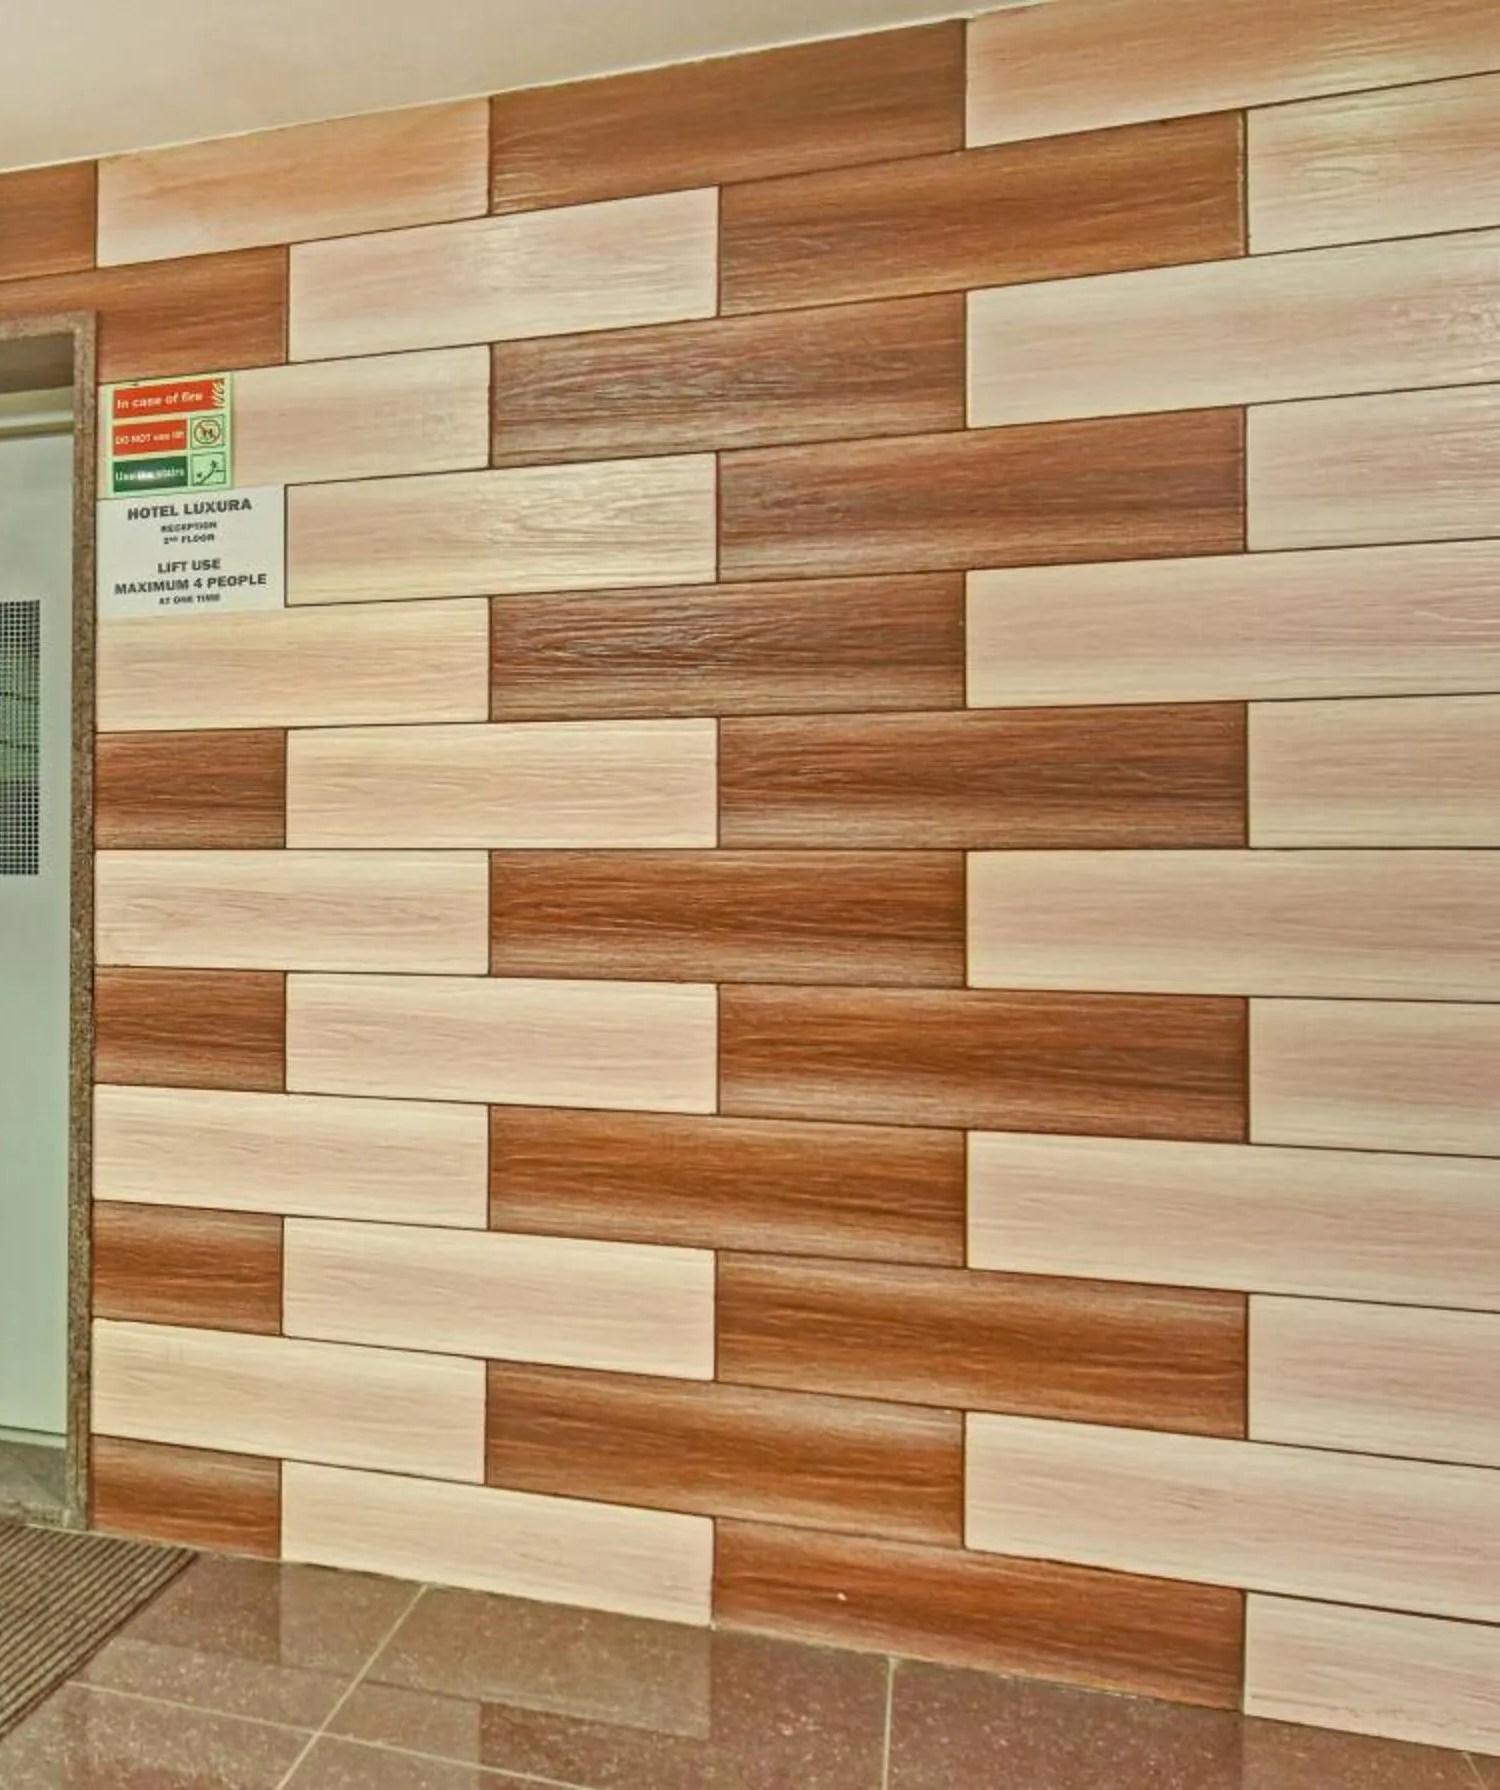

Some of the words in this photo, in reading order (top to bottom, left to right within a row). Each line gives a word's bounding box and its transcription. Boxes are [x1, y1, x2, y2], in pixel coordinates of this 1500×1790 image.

[117, 400, 129, 409] In
[132, 398, 162, 408] case
[164, 392, 179, 405] of
[181, 391, 203, 402] fire
[115, 435, 130, 445] DO
[131, 433, 151, 444] NOT
[127, 505, 178, 520] HOTEL
[183, 498, 252, 515] LUXURA
[160, 521, 217, 533] RECEPTION
[181, 533, 215, 543] FLOOR
[157, 560, 187, 573] LIFT
[191, 558, 221, 571] USE
[114, 578, 189, 595] MAXIMUM
[193, 578, 203, 589] 4
[207, 573, 267, 588] PEOPLE
[158, 597, 170, 605] AT
[173, 595, 193, 605] ONE
[196, 593, 221, 603] TIME
